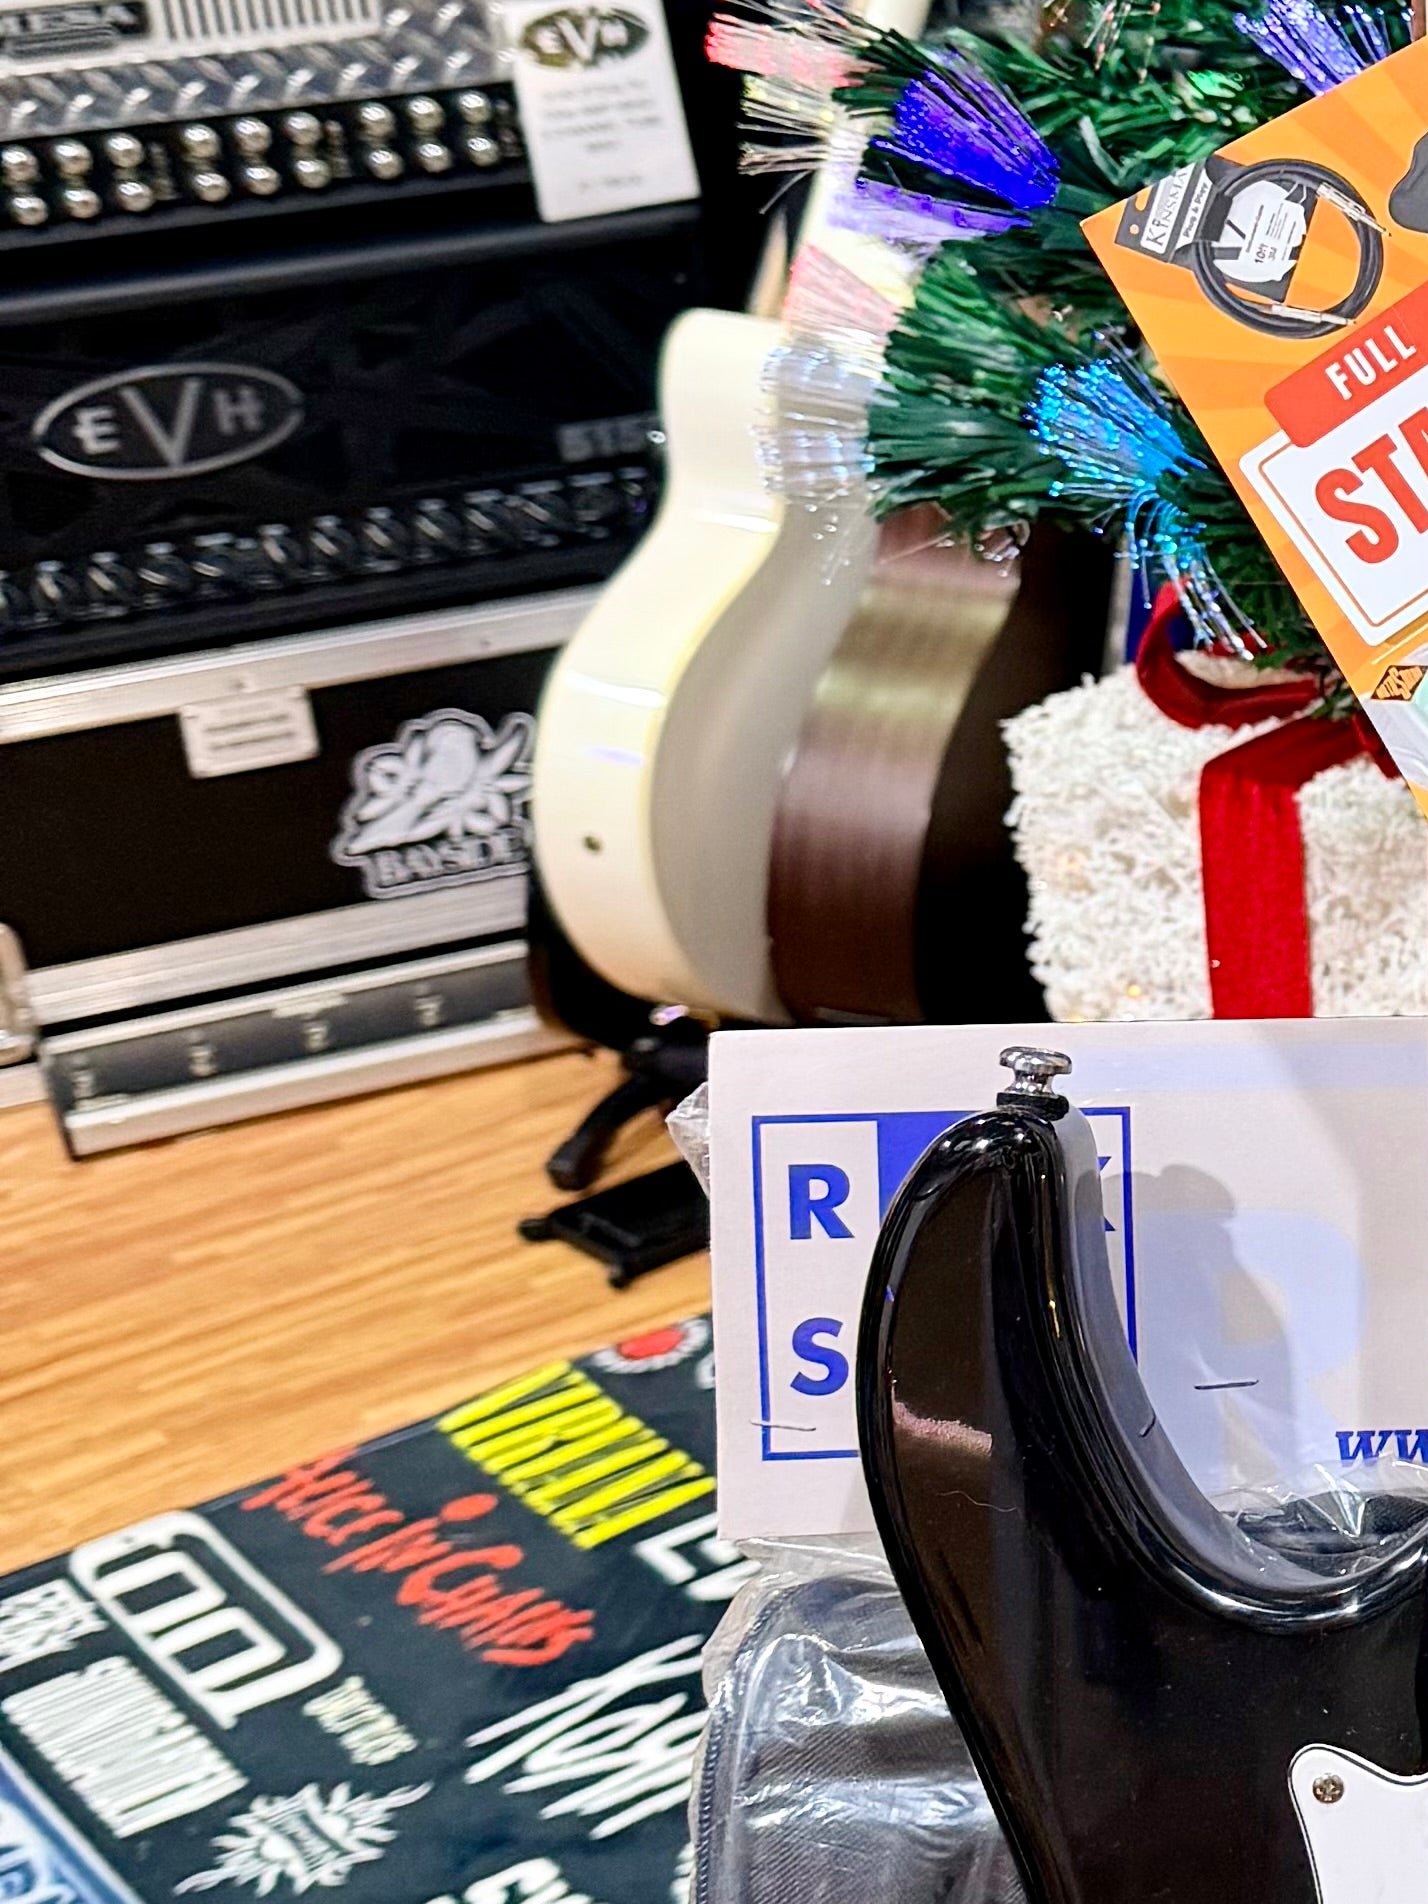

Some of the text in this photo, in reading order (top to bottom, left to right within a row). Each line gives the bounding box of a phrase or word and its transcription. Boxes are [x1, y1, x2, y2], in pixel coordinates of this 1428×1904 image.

[1145, 170, 1190, 247] KINSMA
[1325, 324, 1416, 400] FULL
[72, 378, 265, 469] EVH
